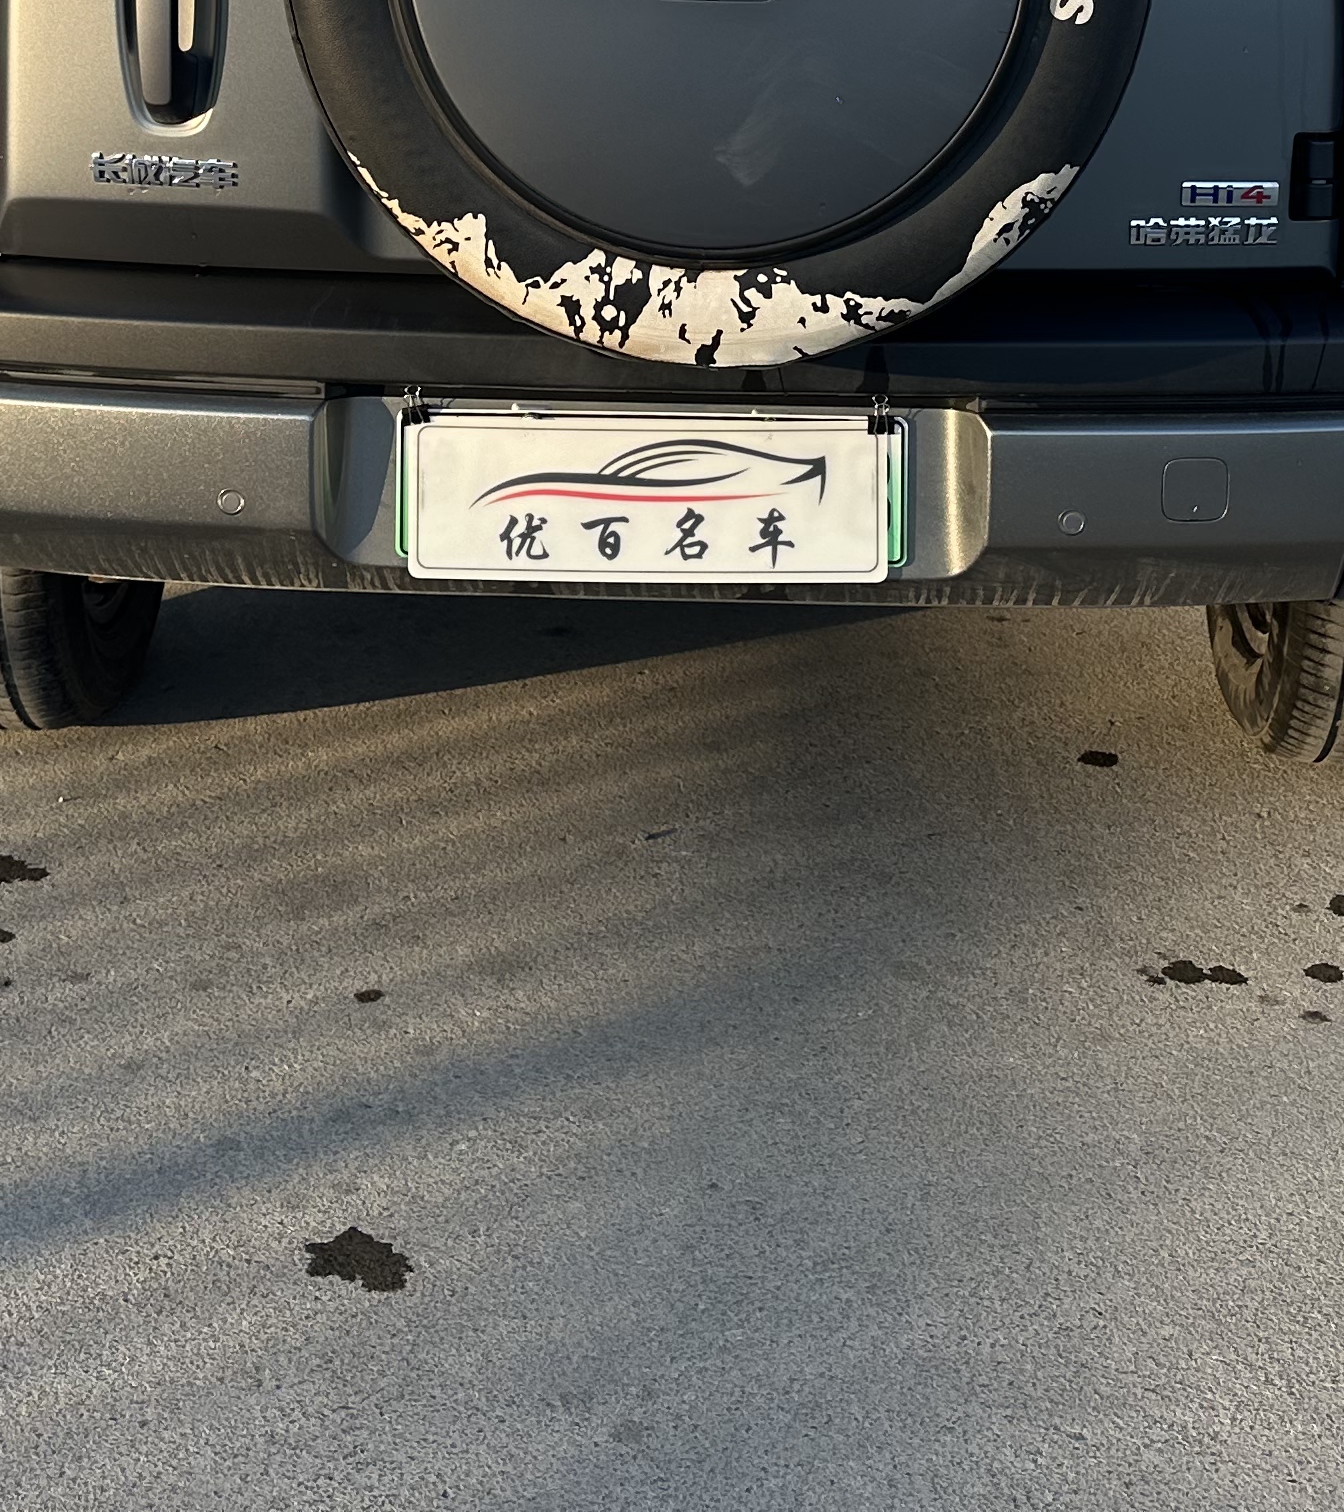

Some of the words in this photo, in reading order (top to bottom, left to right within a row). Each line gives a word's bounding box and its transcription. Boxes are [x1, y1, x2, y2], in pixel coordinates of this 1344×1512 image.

[1189, 185, 1271, 205] Hi4
[1129, 216, 1279, 246] 哈弗猛龙
[499, 508, 795, 568] 优百名车
